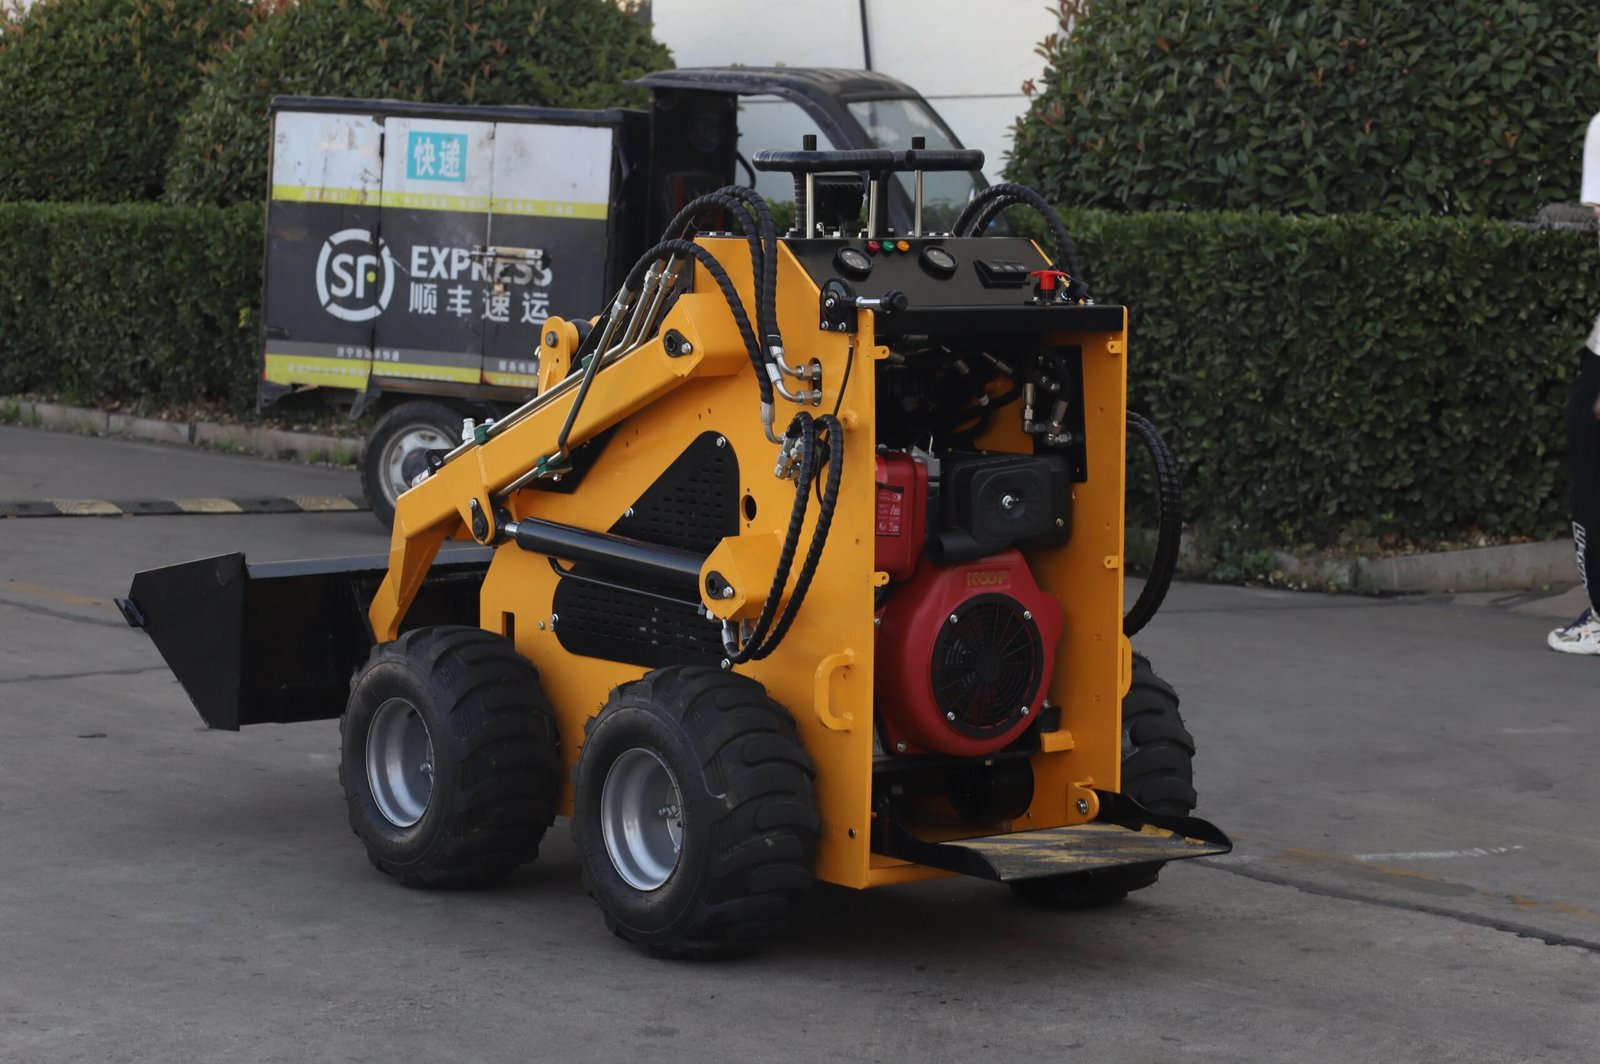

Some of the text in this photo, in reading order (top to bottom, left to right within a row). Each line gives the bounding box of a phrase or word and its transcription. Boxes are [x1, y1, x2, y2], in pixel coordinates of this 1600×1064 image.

[413, 136, 461, 178] 快递
[330, 252, 380, 299] SF
[409, 281, 550, 325] 顺丰速运
